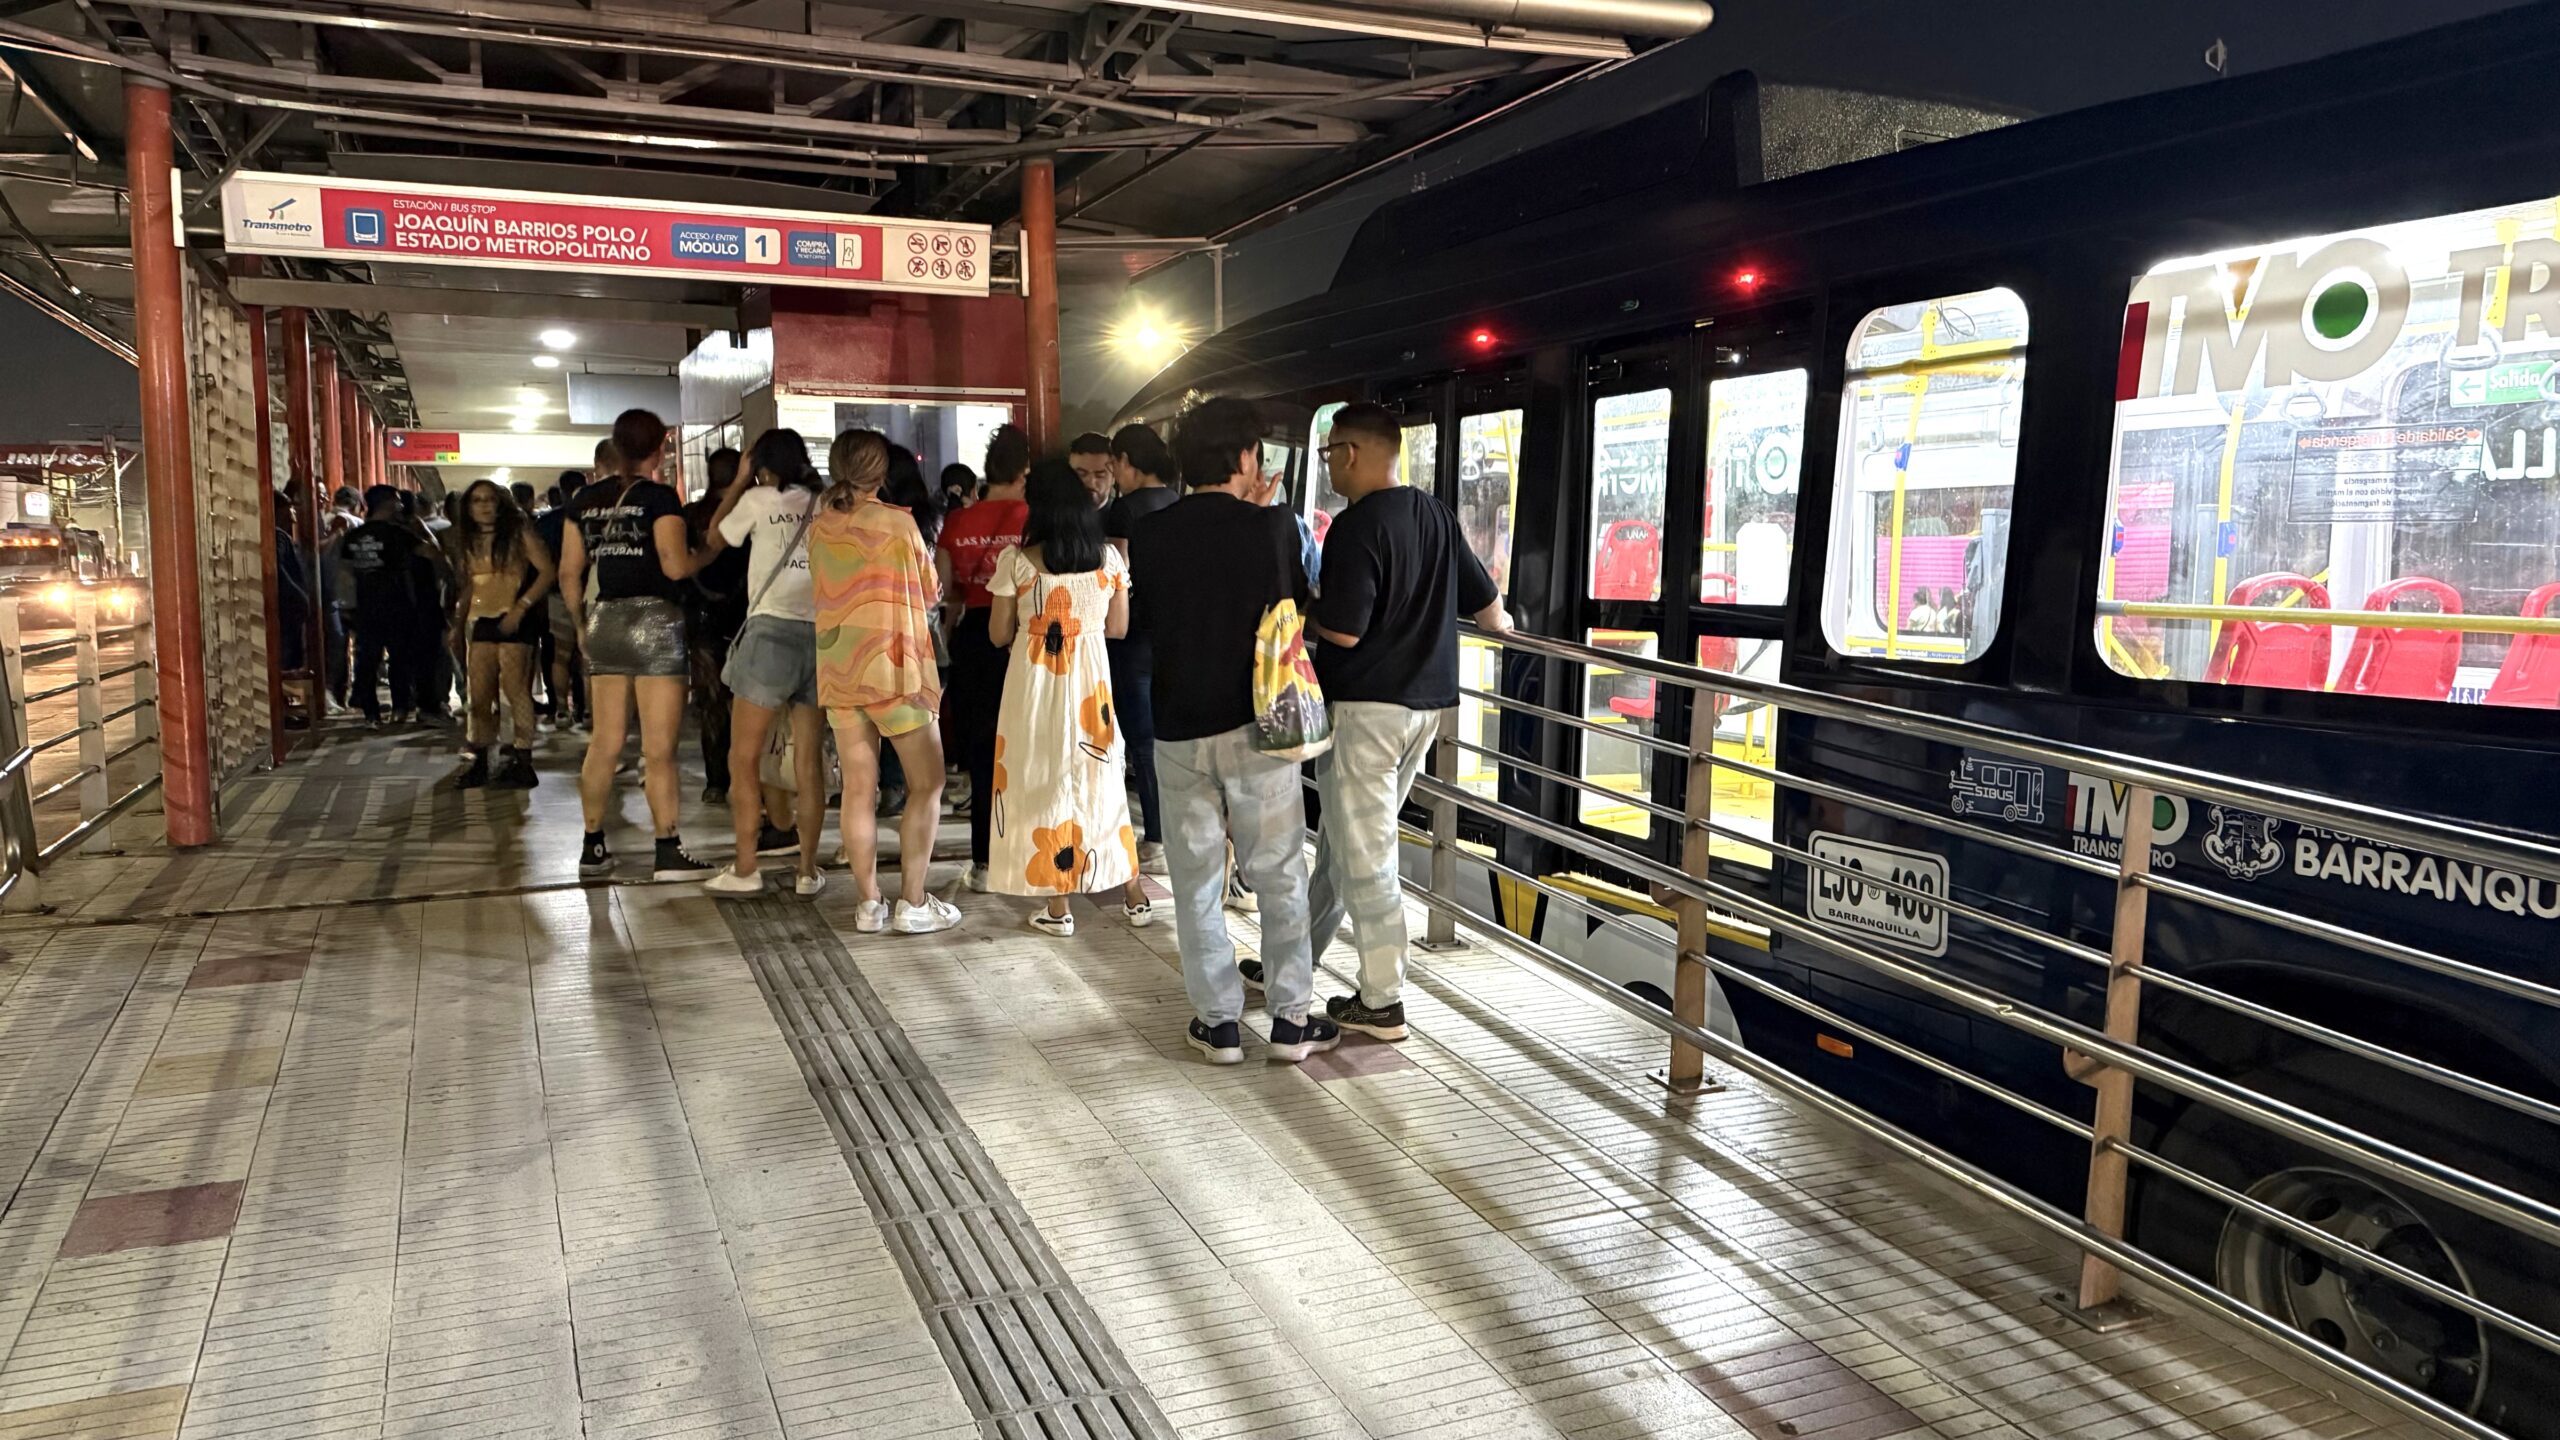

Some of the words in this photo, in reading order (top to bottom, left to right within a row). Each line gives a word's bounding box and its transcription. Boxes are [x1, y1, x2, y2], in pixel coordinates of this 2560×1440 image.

[393, 199, 442, 211] ESTACIÓN
[450, 203, 469, 213] BUS
[471, 204, 496, 214] STOP
[242, 219, 312, 232] Transmetro
[393, 213, 488, 234] JOAQUÍN
[495, 219, 577, 240] BARRIOS
[583, 225, 635, 243] POLO
[396, 231, 480, 251] ESTADIO
[486, 237, 651, 261] METROPOLITANO
[679, 240, 739, 256] MÓDULO
[754, 234, 766, 258] 1
[680, 231, 710, 241] ACCESO
[716, 233, 739, 243] ENTRY
[797, 240, 828, 249] COMPRA
[2130, 238, 2410, 399] TMO
[2489, 368, 2540, 389] Salida
[0, 453, 106, 466] IMPICA
[769, 513, 794, 525] LAS
[956, 536, 978, 546] LAS
[1975, 785, 2014, 801] SIBUS
[2073, 835, 2176, 869] TRANSTRO
[1820, 851, 1863, 906] LJO
[2295, 838, 2560, 919] BARRANQU
[1829, 908, 1921, 939] BARRANQUILLA
